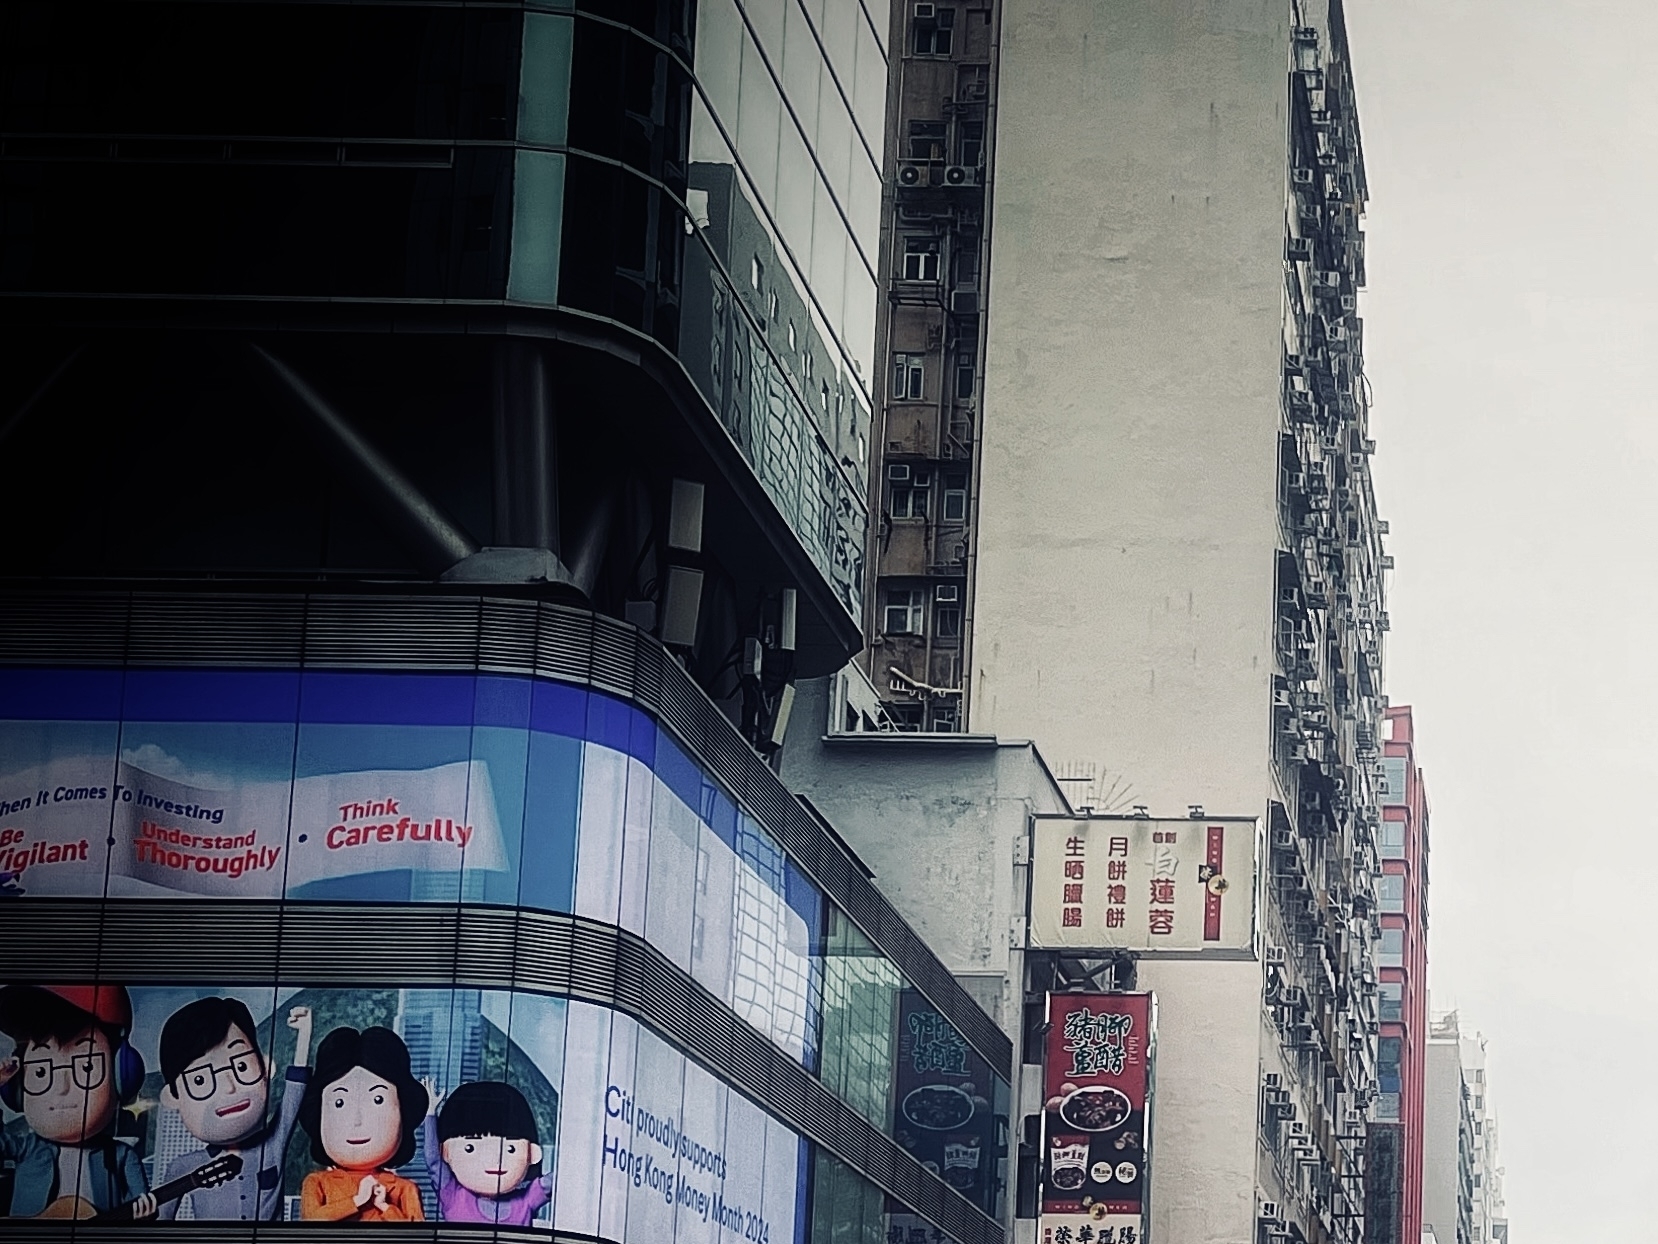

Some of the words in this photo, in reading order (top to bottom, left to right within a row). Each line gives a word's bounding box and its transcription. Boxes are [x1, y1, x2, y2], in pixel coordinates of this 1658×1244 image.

[0, 797, 31, 816] hen
[36, 790, 49, 806] It
[53, 785, 107, 802] Comes
[113, 785, 132, 803] To
[137, 790, 224, 824] Investing
[339, 798, 400, 822] Think
[0, 829, 24, 847] Be
[142, 820, 257, 849] Understand
[326, 817, 473, 850] Carefully
[134, 838, 281, 878] Thoroughly
[636, 1107, 680, 1159] proudly
[680, 1132, 727, 1181] supports
[602, 1133, 642, 1188] Hong
[644, 1163, 673, 1205] Kong
[676, 1174, 711, 1223] Money
[711, 1191, 744, 1234] Month
